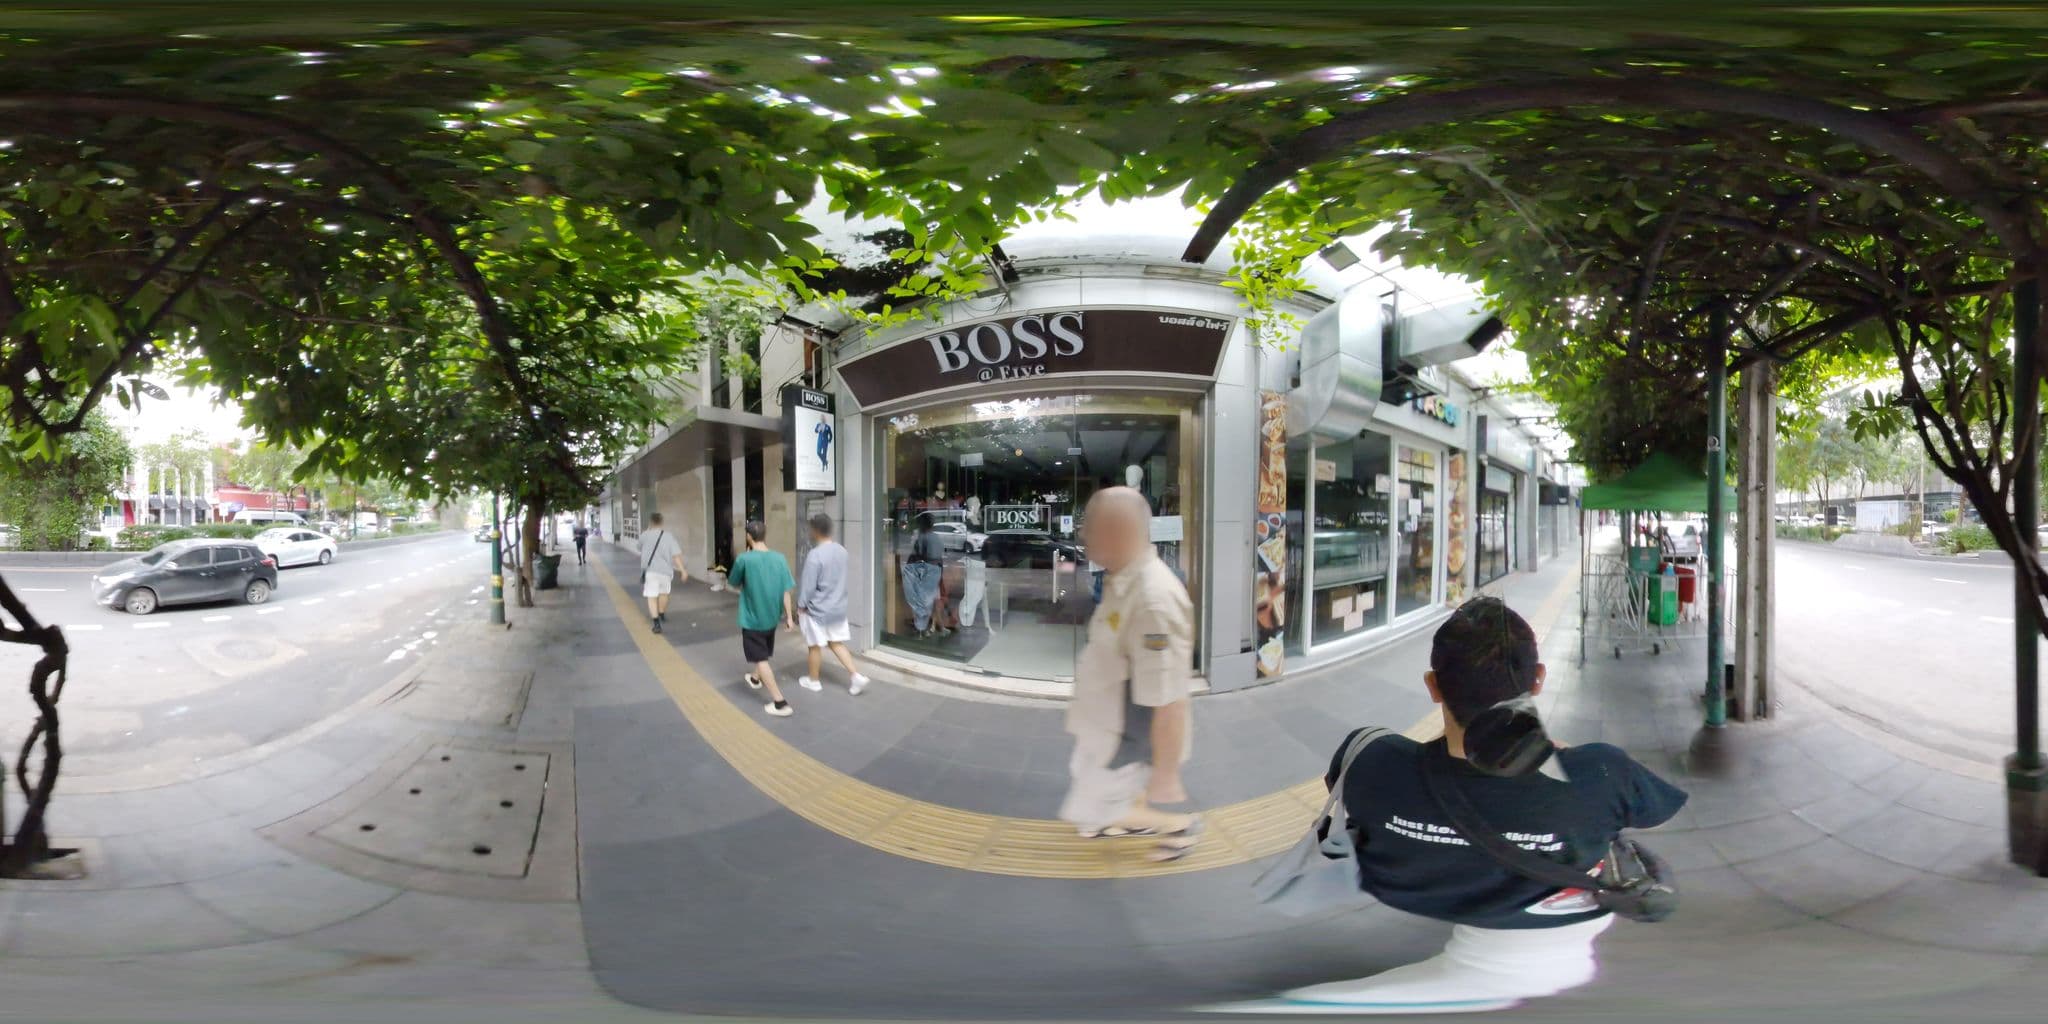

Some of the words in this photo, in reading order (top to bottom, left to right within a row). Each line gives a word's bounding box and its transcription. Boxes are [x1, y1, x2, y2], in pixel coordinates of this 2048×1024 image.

[925, 312, 1084, 373] BOSS
[978, 368, 993, 382] @
[805, 392, 825, 405] BOSS
[997, 510, 1038, 524] BOSS
